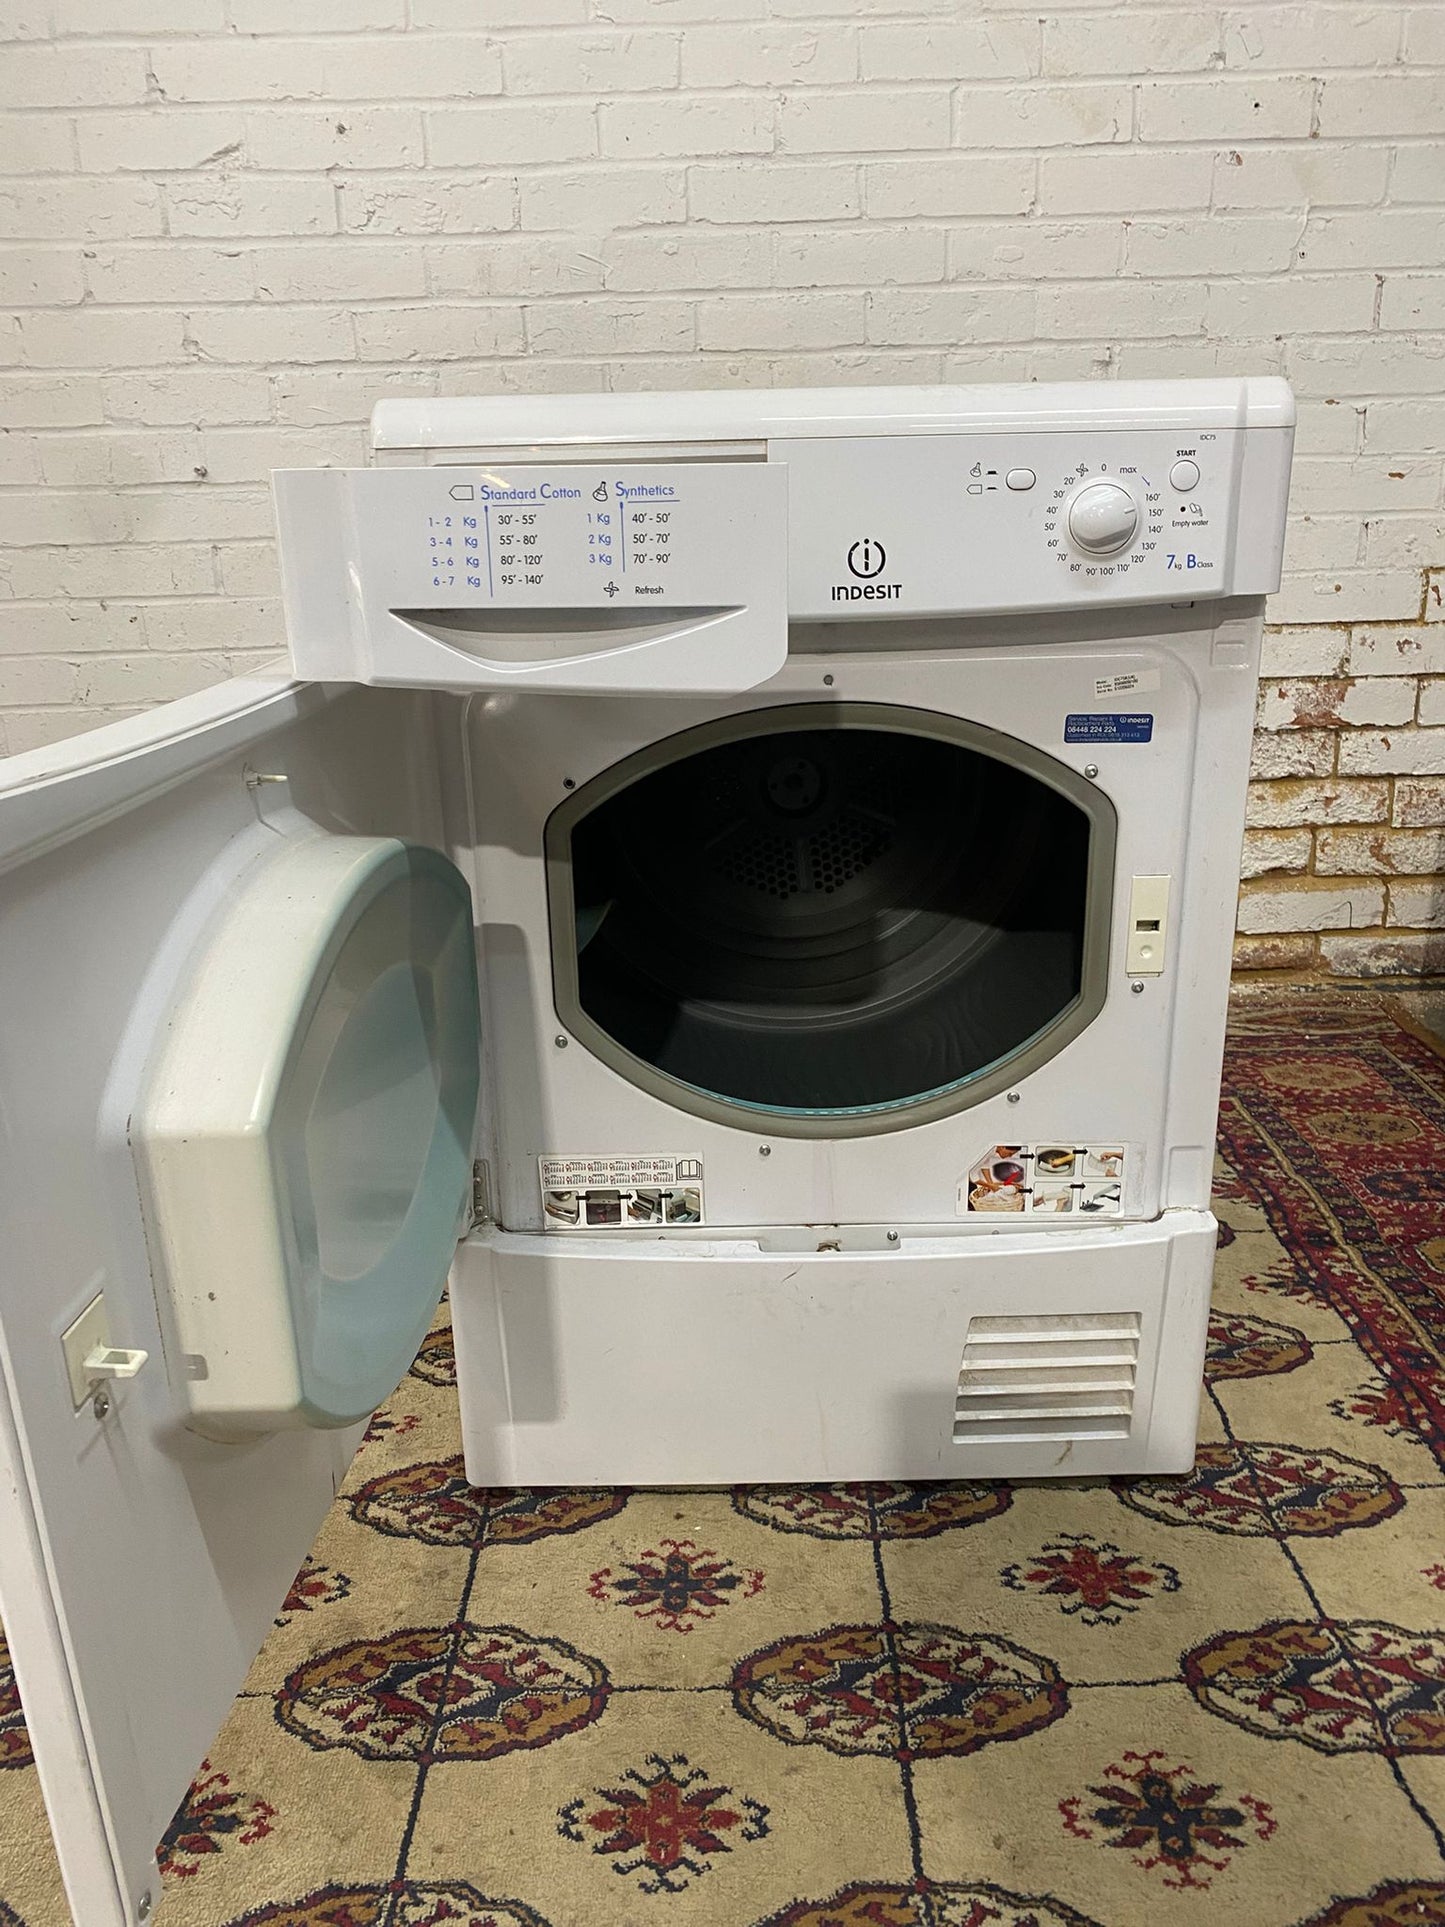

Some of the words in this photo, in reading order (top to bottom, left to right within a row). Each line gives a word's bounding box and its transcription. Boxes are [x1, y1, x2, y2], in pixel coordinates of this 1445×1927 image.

[1101, 464, 1107, 472] 0
[1120, 466, 1137, 474] max
[481, 485, 536, 500] Standard
[540, 483, 581, 498] Cotton
[615, 481, 675, 499] Synthetics
[428, 517, 433, 527] 1
[445, 516, 452, 527] 2
[463, 516, 477, 529] Kg
[587, 513, 592, 523] 1
[597, 513, 610, 525] Kg
[1171, 520, 1190, 528] Empty
[430, 537, 437, 547] 3
[446, 537, 452, 547] 4
[464, 537, 478, 549] Kg
[588, 534, 595, 544] 2
[598, 534, 611, 546] Kg
[432, 557, 438, 567] 5
[447, 557, 454, 567] 6
[466, 556, 479, 568] Kg
[589, 554, 595, 564] 3
[599, 553, 612, 566] Kg
[433, 576, 440, 586] 6
[448, 576, 455, 586] 7
[467, 576, 480, 588] Kg
[635, 586, 664, 595] Refresh
